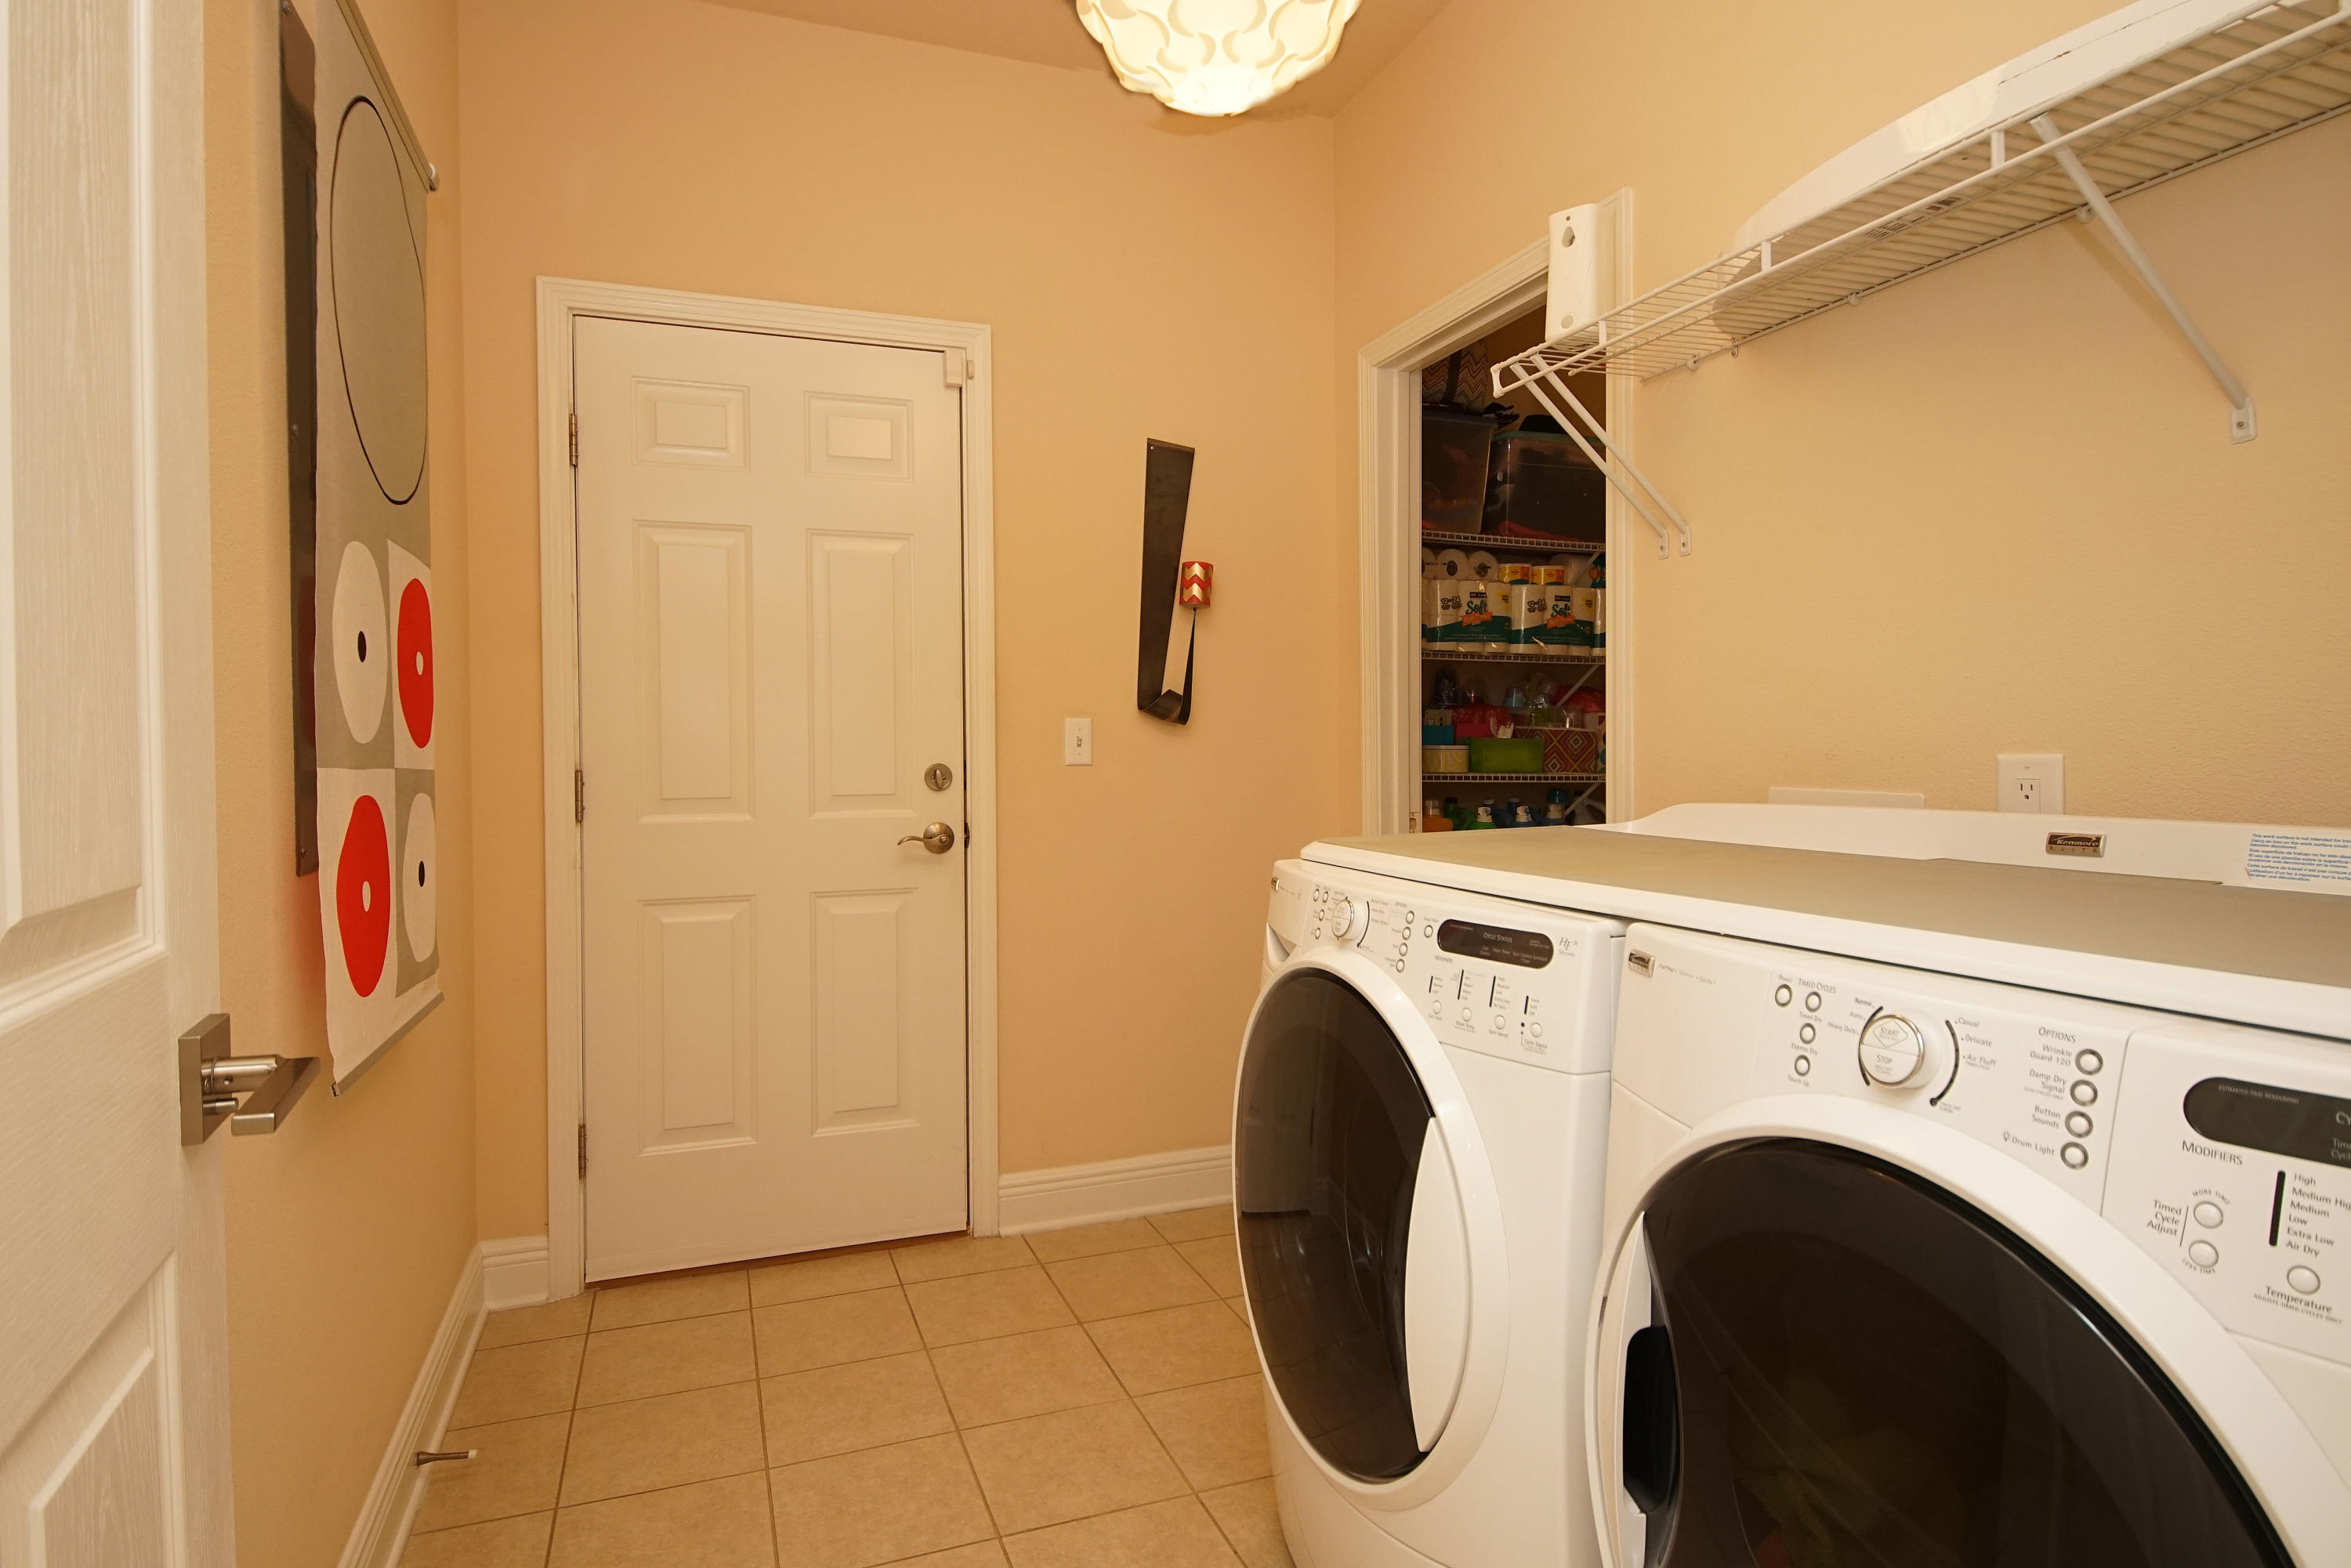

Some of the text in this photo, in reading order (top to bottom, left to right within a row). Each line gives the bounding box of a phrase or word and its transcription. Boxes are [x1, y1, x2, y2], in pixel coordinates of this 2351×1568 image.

[1465, 599, 1487, 614] Soft
[1799, 978, 1837, 994] TIMED CYCLES
[1855, 998, 1873, 1007] Normal
[1958, 1017, 1980, 1028] Casual
[1881, 1027, 1899, 1036] START
[2038, 1027, 2076, 1043] OPTIONS
[1965, 1034, 1993, 1047] Delicate
[2030, 1050, 2071, 1066] Guard 120
[2042, 1044, 2072, 1057] Wrinkle
[1876, 1054, 1893, 1064] STOP
[1980, 1056, 1997, 1066] Fluff
[2029, 1069, 2067, 1085] Damp Dry
[2041, 1081, 2065, 1093] Signal
[2034, 1105, 2061, 1119] Button
[2031, 1114, 2059, 1129] Sounds
[2012, 1135, 2055, 1156] Drum Light
[2183, 1139, 2244, 1166] MODIFIERS
[2294, 1173, 2316, 1186] High
[2292, 1186, 2331, 1204] Medium
[2154, 1200, 2183, 1215] Timed
[2291, 1200, 2330, 1218] Medium
[2155, 1211, 2180, 1226] Cycle
[2288, 1214, 2308, 1226] Low
[2146, 1220, 2177, 1237] Adjust
[2287, 1226, 2335, 1246] Extra Low
[2286, 1240, 2320, 1258] Air Dry
[2266, 1284, 2332, 1313] Temperature
